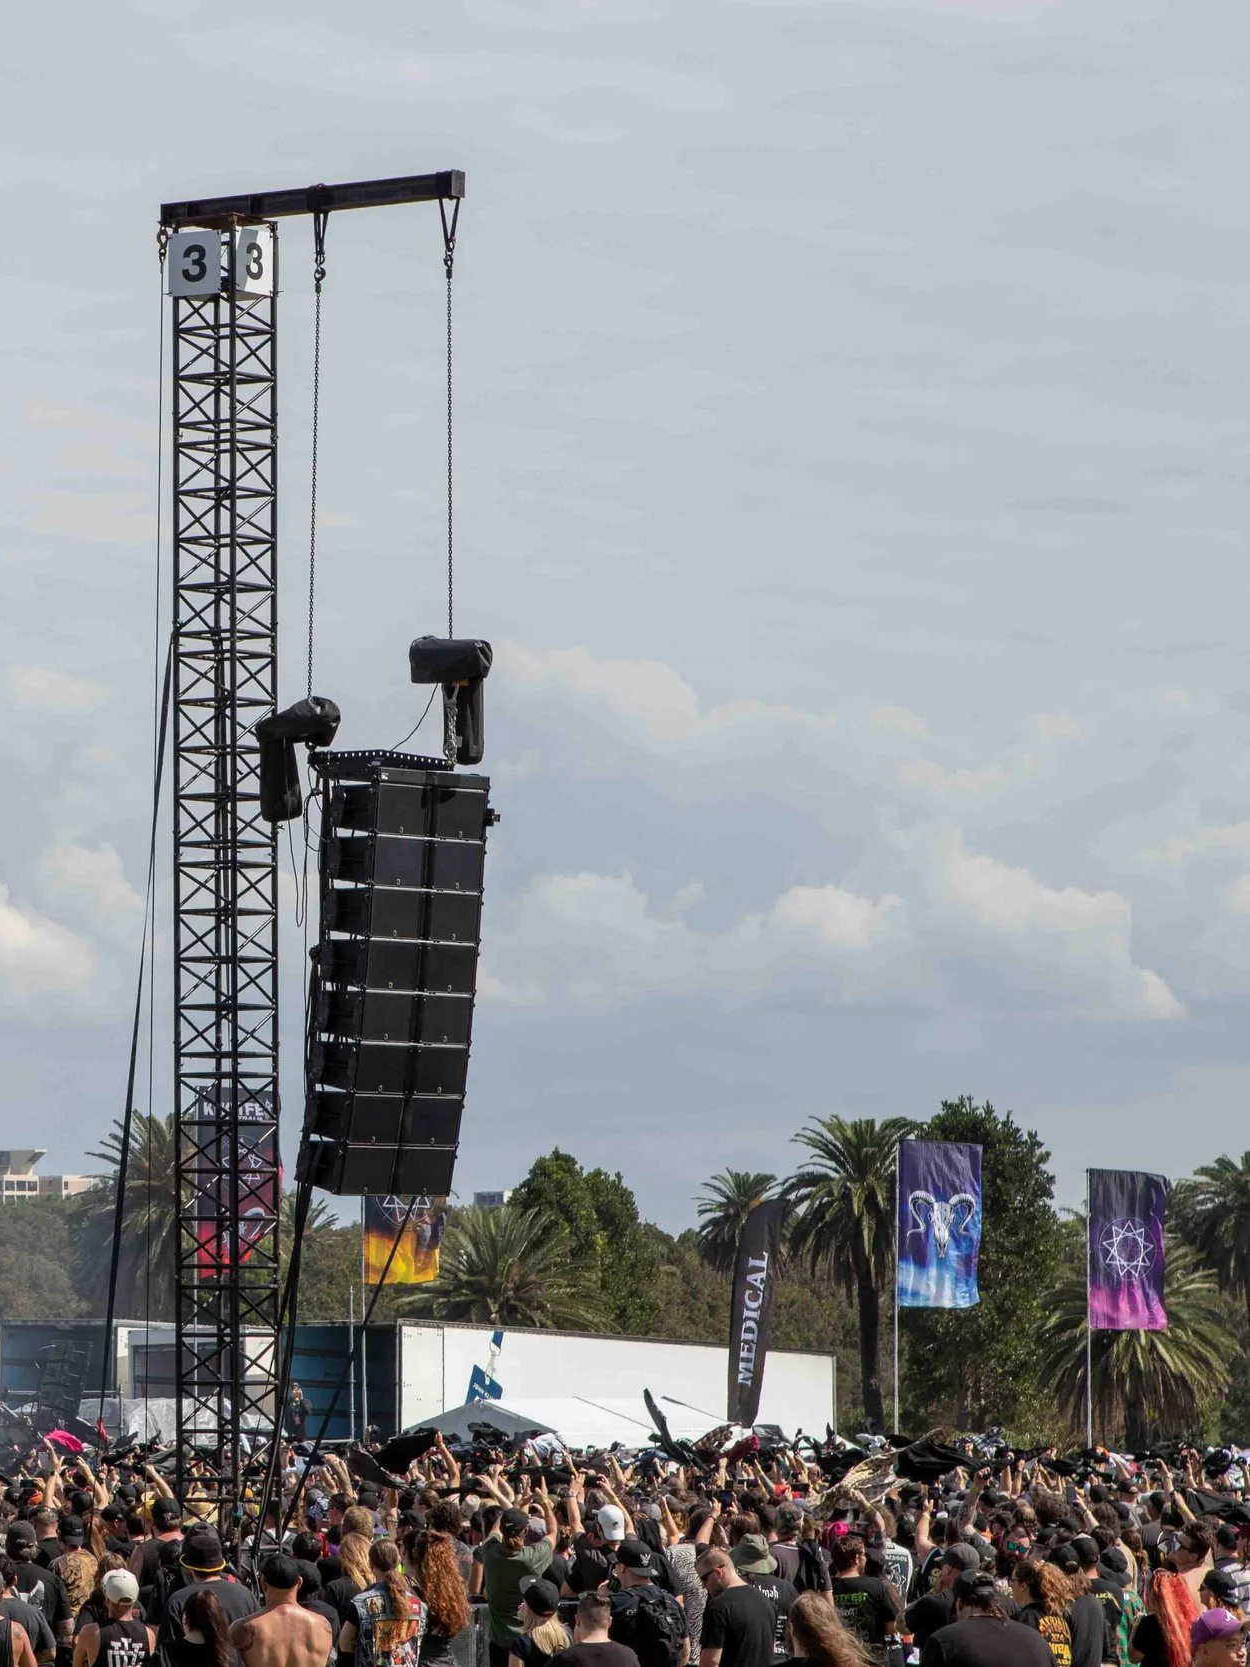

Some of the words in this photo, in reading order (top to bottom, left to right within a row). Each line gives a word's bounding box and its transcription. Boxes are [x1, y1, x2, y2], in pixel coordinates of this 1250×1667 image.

[182, 245, 206, 282] 3
[246, 242, 263, 280] 3
[737, 1252, 768, 1387] MEDICAL
